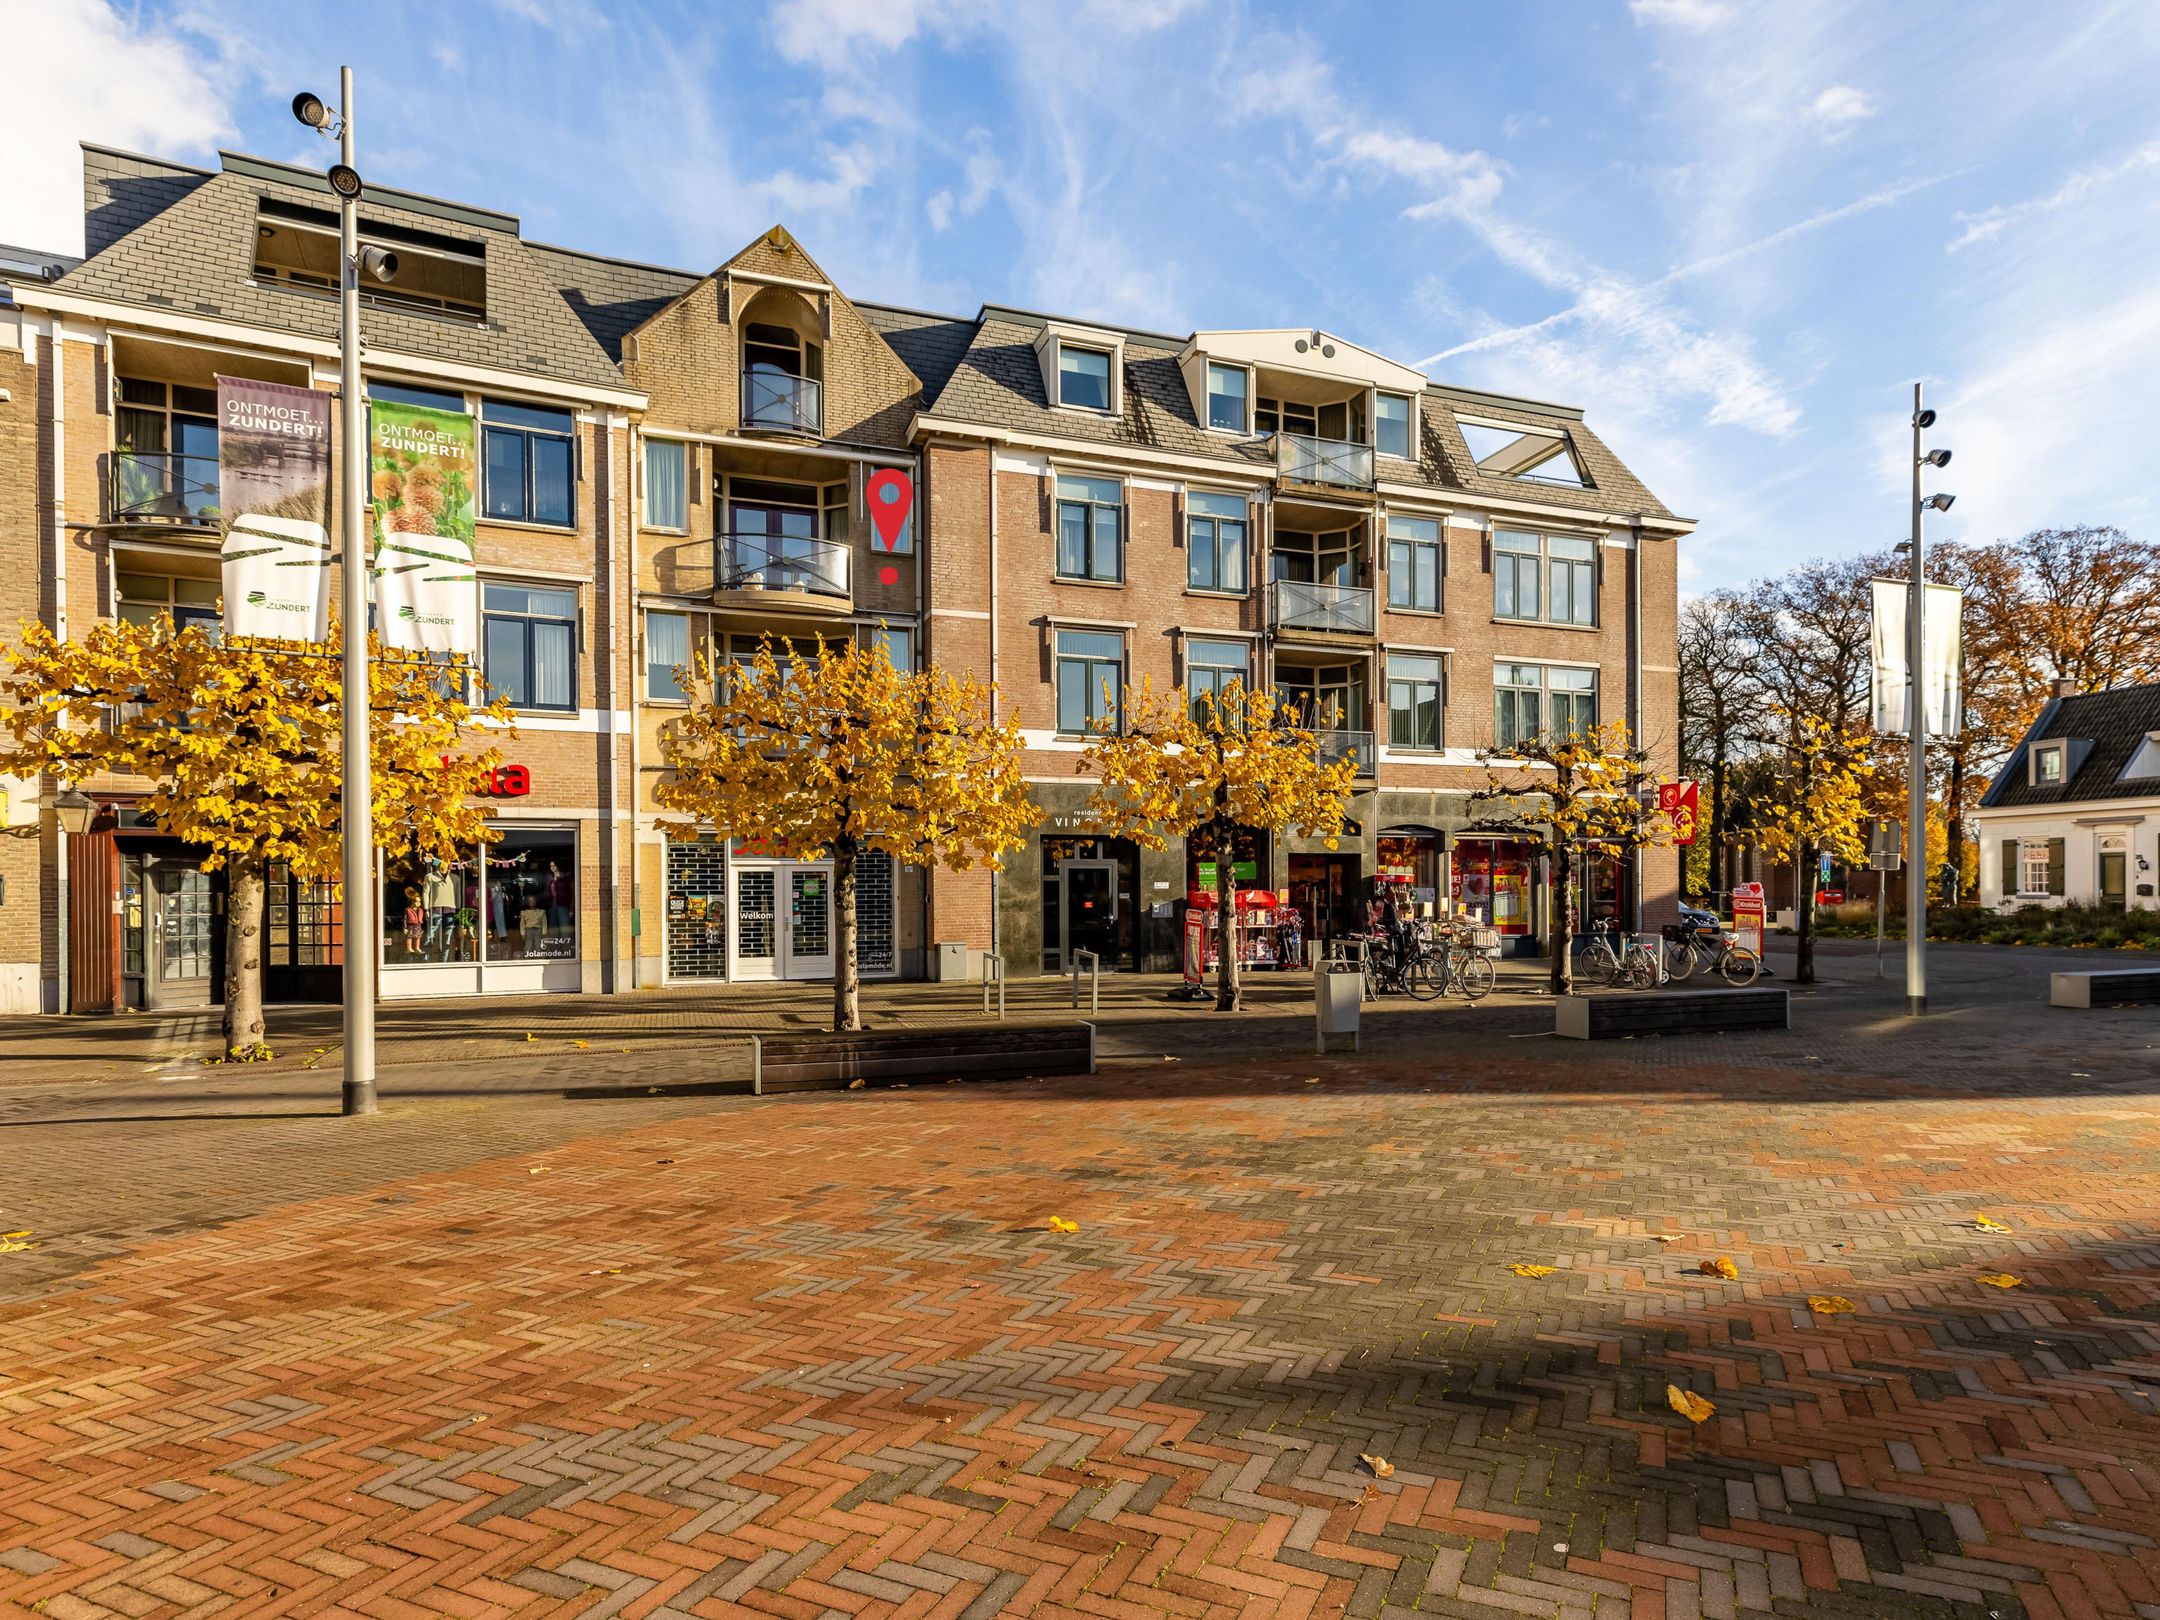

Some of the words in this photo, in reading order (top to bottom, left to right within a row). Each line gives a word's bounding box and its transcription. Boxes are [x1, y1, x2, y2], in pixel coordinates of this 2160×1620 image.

[227, 400, 324, 424] ONTMOET...
[229, 413, 323, 437] ZUNDERT!
[379, 423, 466, 446] ONTMOET...
[381, 436, 465, 459] ZUNDERT!
[266, 603, 310, 612] ZUNDERT
[414, 616, 455, 625] ZUNDERT
[554, 937, 571, 945] 24/7
[524, 950, 571, 958] Jolamode.nl
